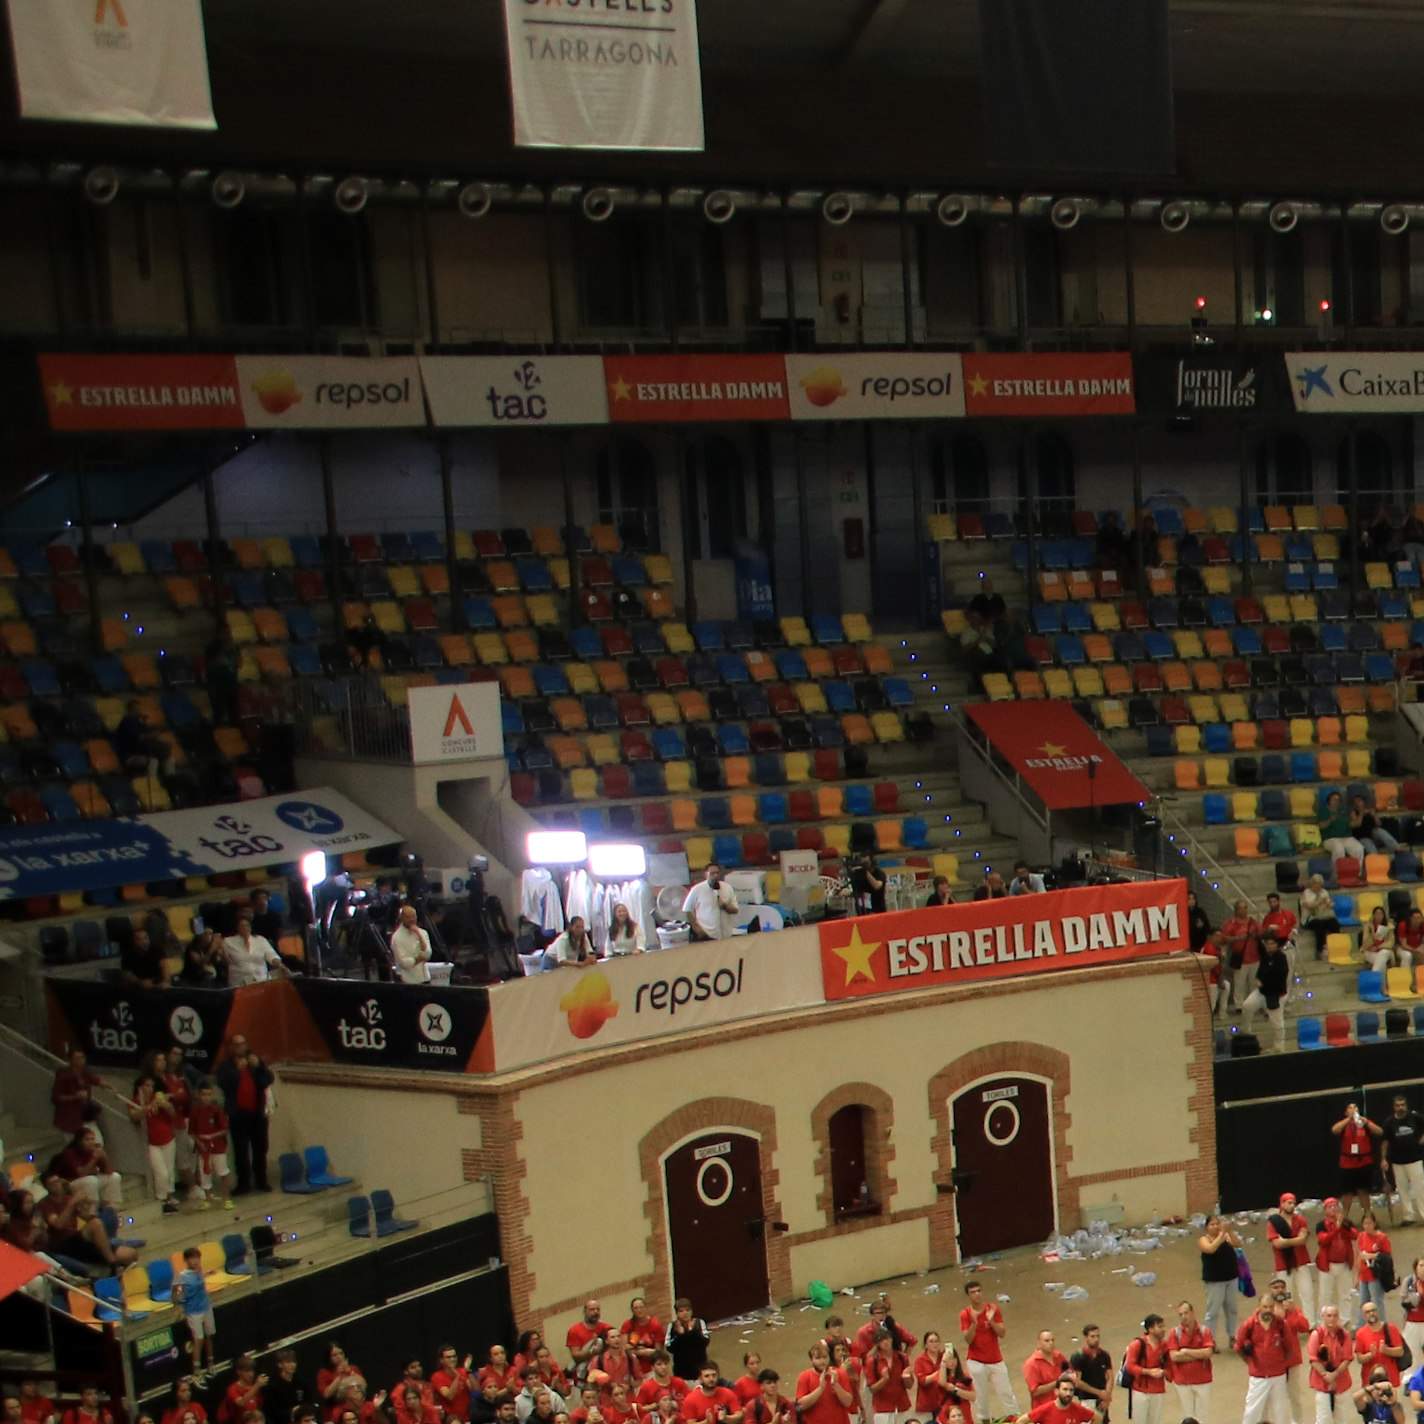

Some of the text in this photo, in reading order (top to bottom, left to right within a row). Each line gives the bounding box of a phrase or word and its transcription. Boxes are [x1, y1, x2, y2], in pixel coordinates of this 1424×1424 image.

[525, 36, 677, 66] TARRAGONA
[79, 385, 236, 408] ESTRELLA DAMM
[315, 378, 410, 409] repsol
[636, 382, 783, 401] ESTRELLA DAMM
[861, 373, 952, 401] repsol
[993, 378, 1130, 398] ESTRELLA DAMM
[486, 386, 548, 420] tac
[198, 834, 284, 858] tac
[887, 904, 1179, 978] ESTRELLA DAMM
[635, 958, 744, 1015] repsol
[89, 1021, 138, 1053] tac
[337, 1018, 387, 1050] tac
[417, 1042, 458, 1057] la xarxa
